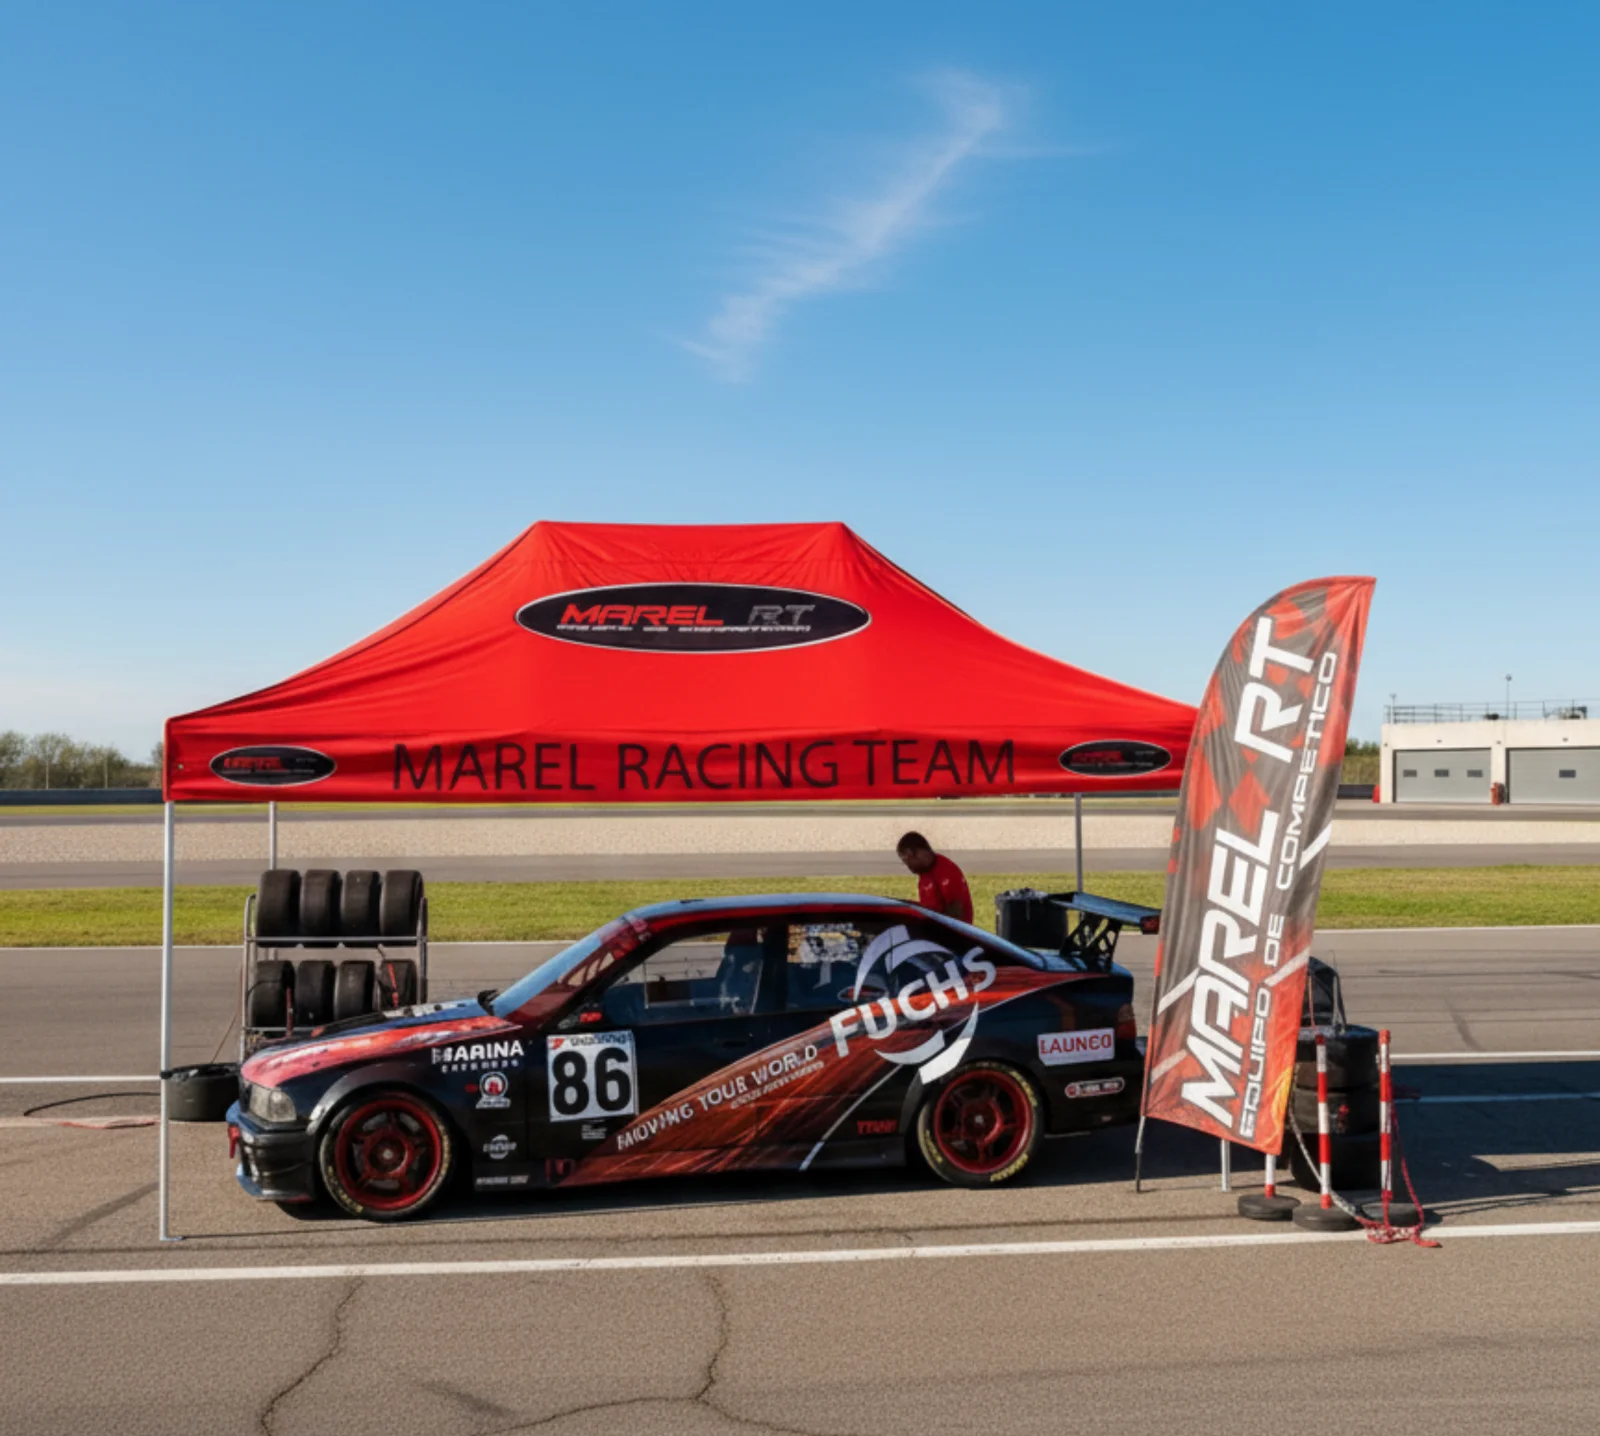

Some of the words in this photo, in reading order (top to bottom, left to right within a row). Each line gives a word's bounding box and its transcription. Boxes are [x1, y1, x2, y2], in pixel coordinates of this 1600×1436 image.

[560, 603, 724, 626] MAREL
[747, 604, 815, 626] RT
[393, 743, 596, 790] MAREL
[617, 740, 838, 790] RACING
[852, 739, 1014, 786] TEAM
[1181, 810, 1280, 1129] MAREL
[1234, 616, 1314, 763] RT
[829, 946, 997, 1058] FUCHS
[1239, 987, 1272, 1141] EQUIPO
[1264, 913, 1285, 968] DE
[552, 1047, 632, 1116] 86
[698, 1075, 747, 1112] YOUR
[751, 1044, 818, 1086] WORLD
